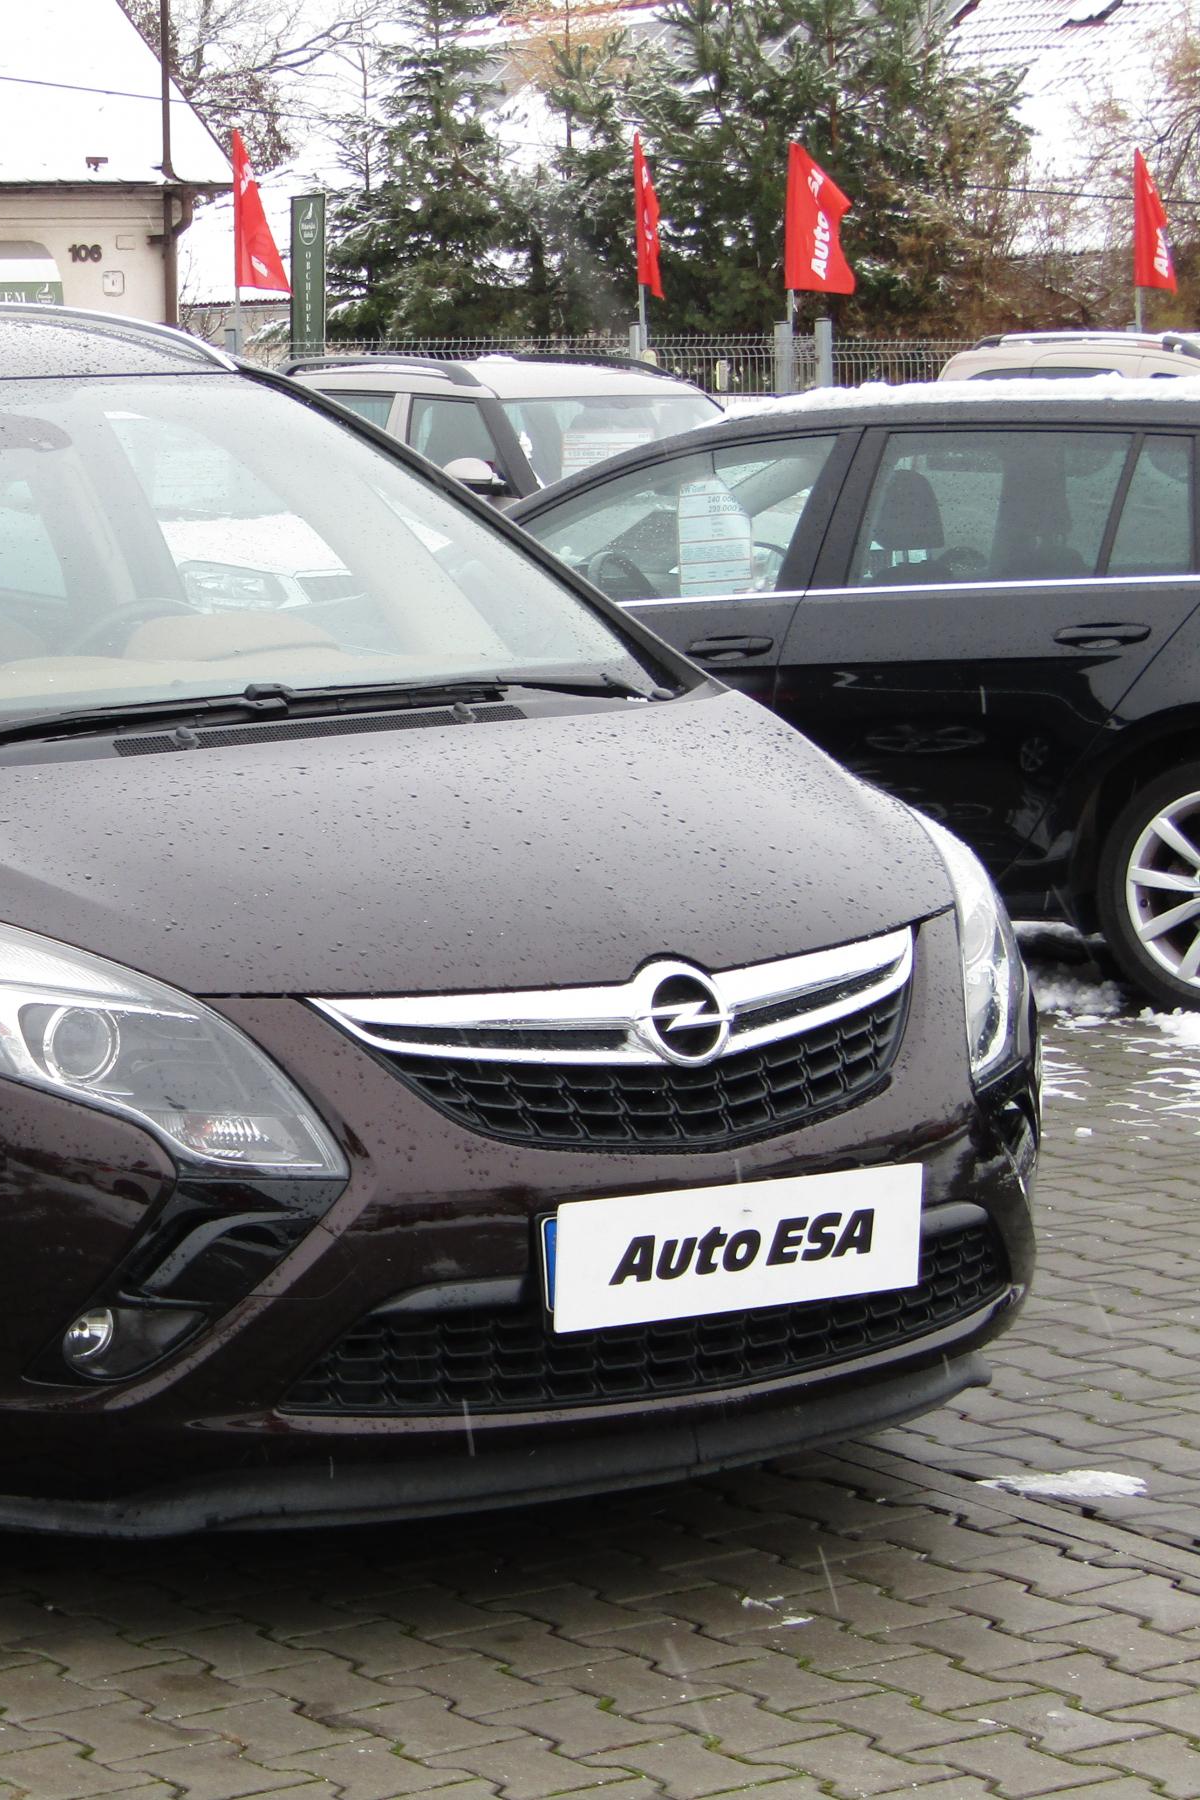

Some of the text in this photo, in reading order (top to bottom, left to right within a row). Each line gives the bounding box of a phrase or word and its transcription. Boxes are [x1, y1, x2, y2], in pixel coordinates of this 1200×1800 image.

[68, 244, 102, 263] 106
[810, 210, 831, 280] Auto
[608, 1208, 875, 1286] Auto ESA
